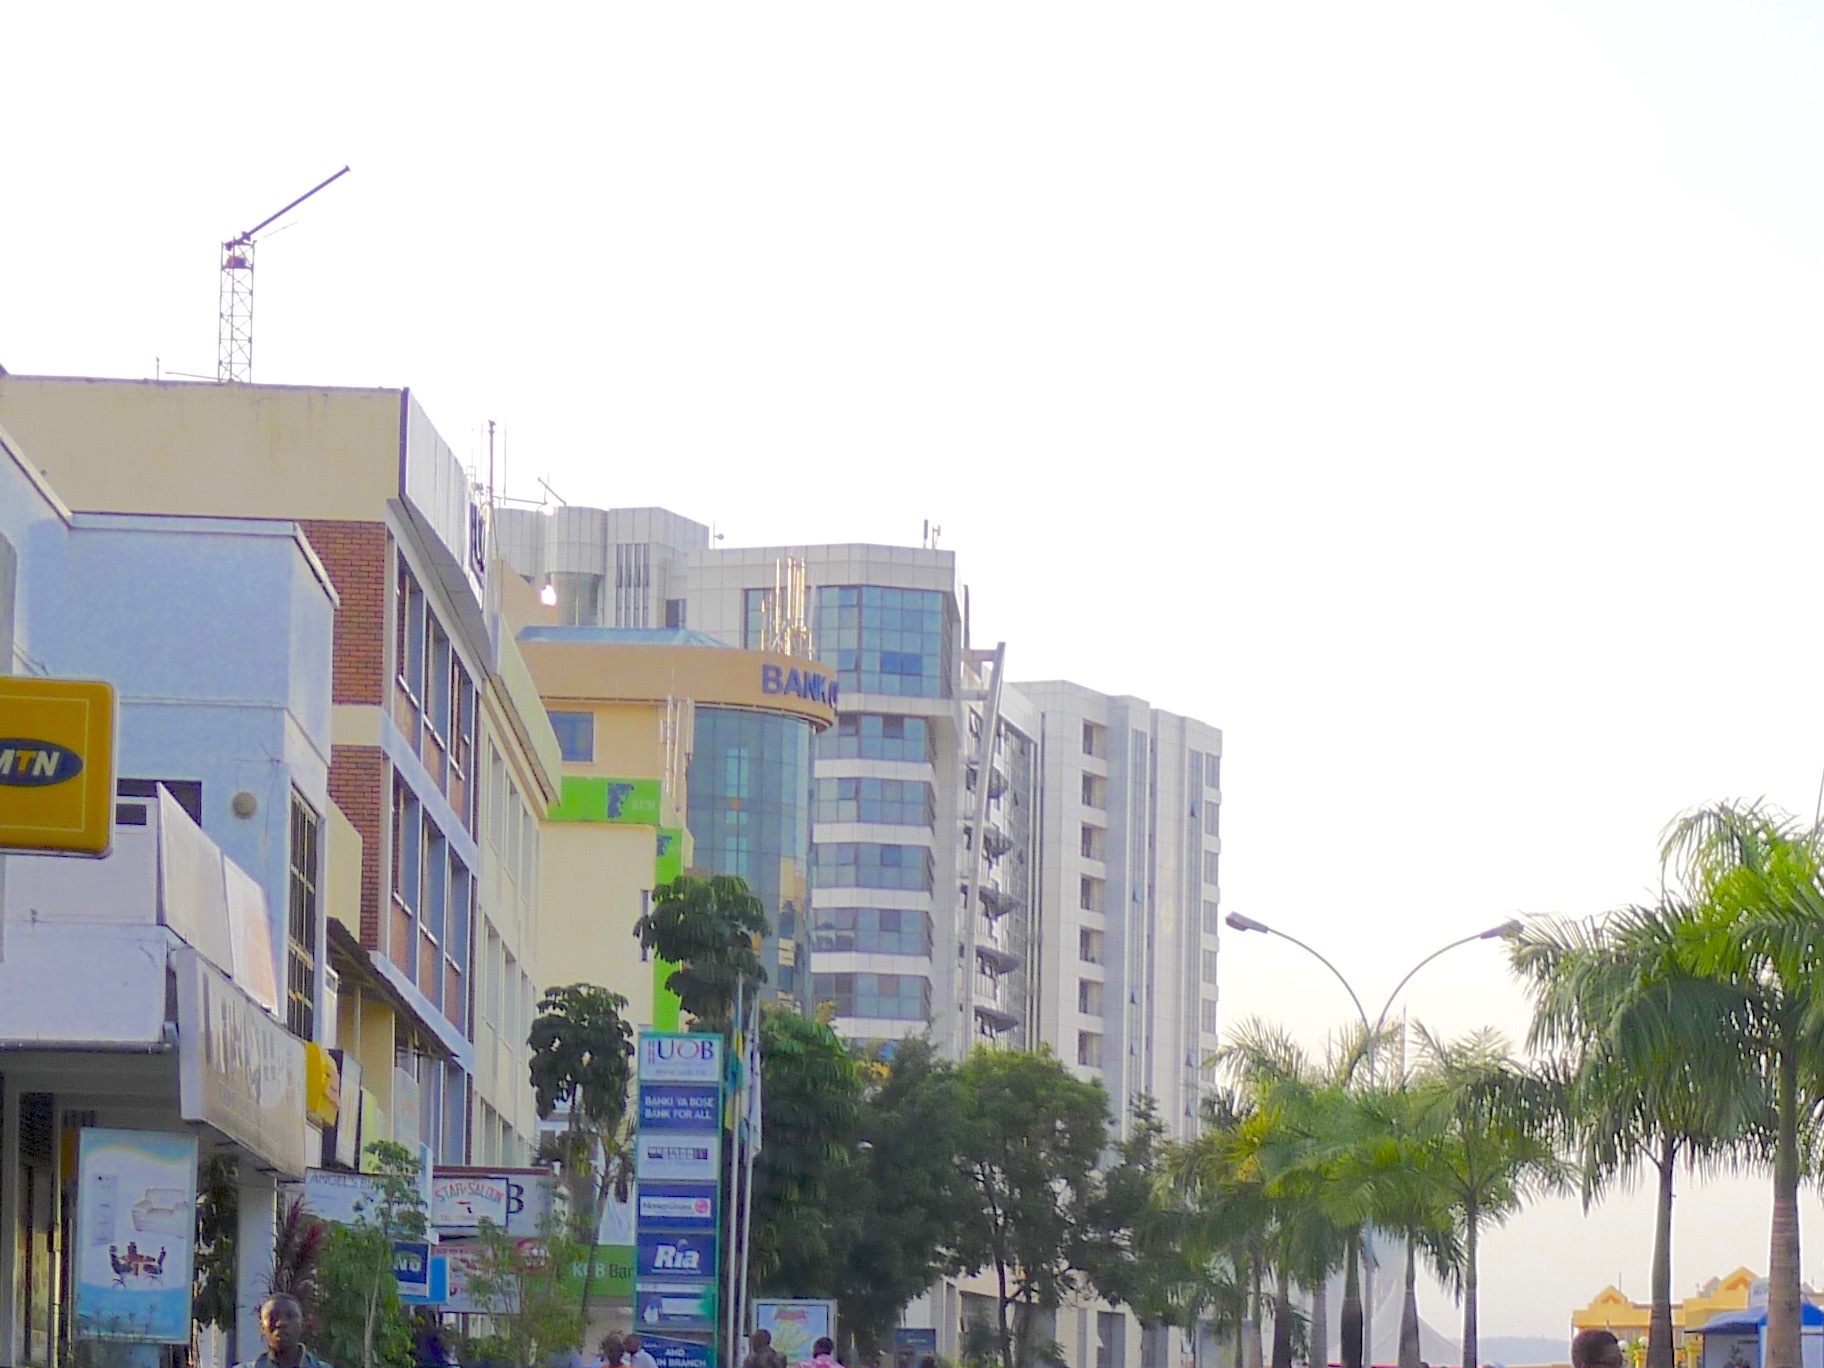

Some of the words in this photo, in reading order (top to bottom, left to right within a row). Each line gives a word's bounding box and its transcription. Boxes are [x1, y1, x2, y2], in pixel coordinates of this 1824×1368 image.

[762, 663, 826, 703] BANK
[657, 1040, 714, 1060] UOB
[644, 1096, 673, 1107] BANKI
[675, 1097, 689, 1107] YA
[644, 1108, 671, 1119] BANK
[672, 1109, 692, 1119] FOR
[694, 1109, 712, 1120] ALL
[653, 1239, 700, 1269] Ria
[572, 1262, 606, 1278] KB
[668, 1358, 707, 1368] BRANCH
